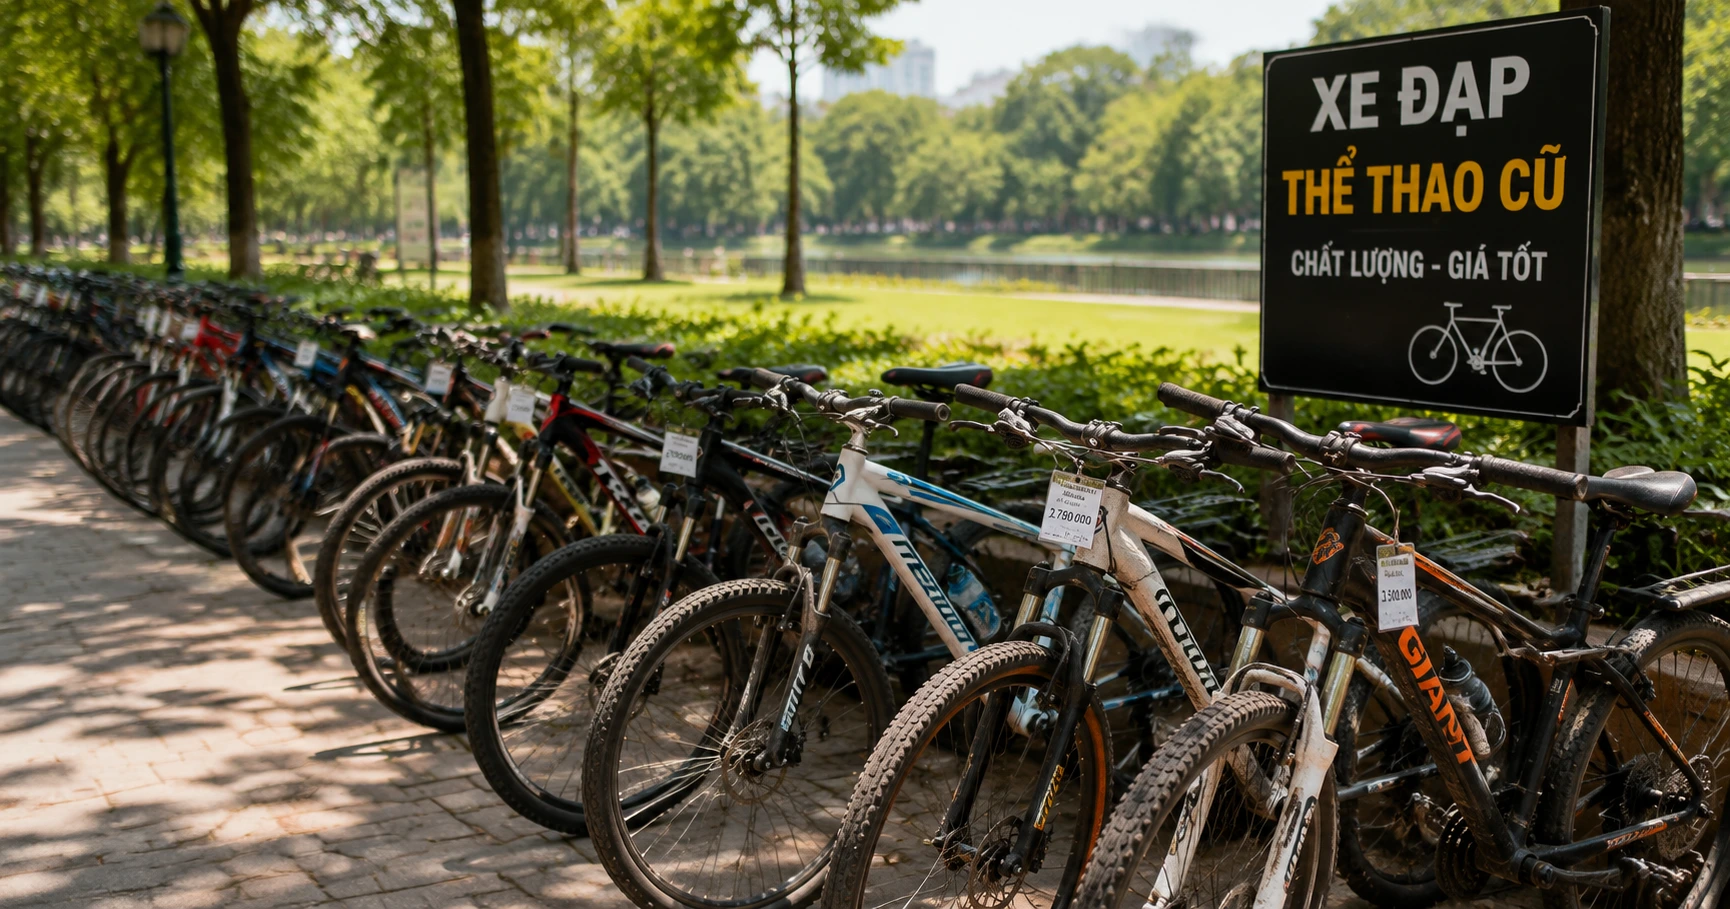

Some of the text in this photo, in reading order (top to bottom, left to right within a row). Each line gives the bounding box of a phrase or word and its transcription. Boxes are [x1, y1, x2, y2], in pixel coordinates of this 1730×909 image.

[1311, 56, 1531, 137] XE ĐẠP
[1282, 144, 1567, 216] THỂ THAO CŨ
[1291, 240, 1345, 277] CHẤT
[1350, 247, 1424, 284] LƯỢNG
[1448, 244, 1490, 280] GIÁ
[1497, 240, 1548, 281] TỐT
[1398, 626, 1476, 765] GIANT
